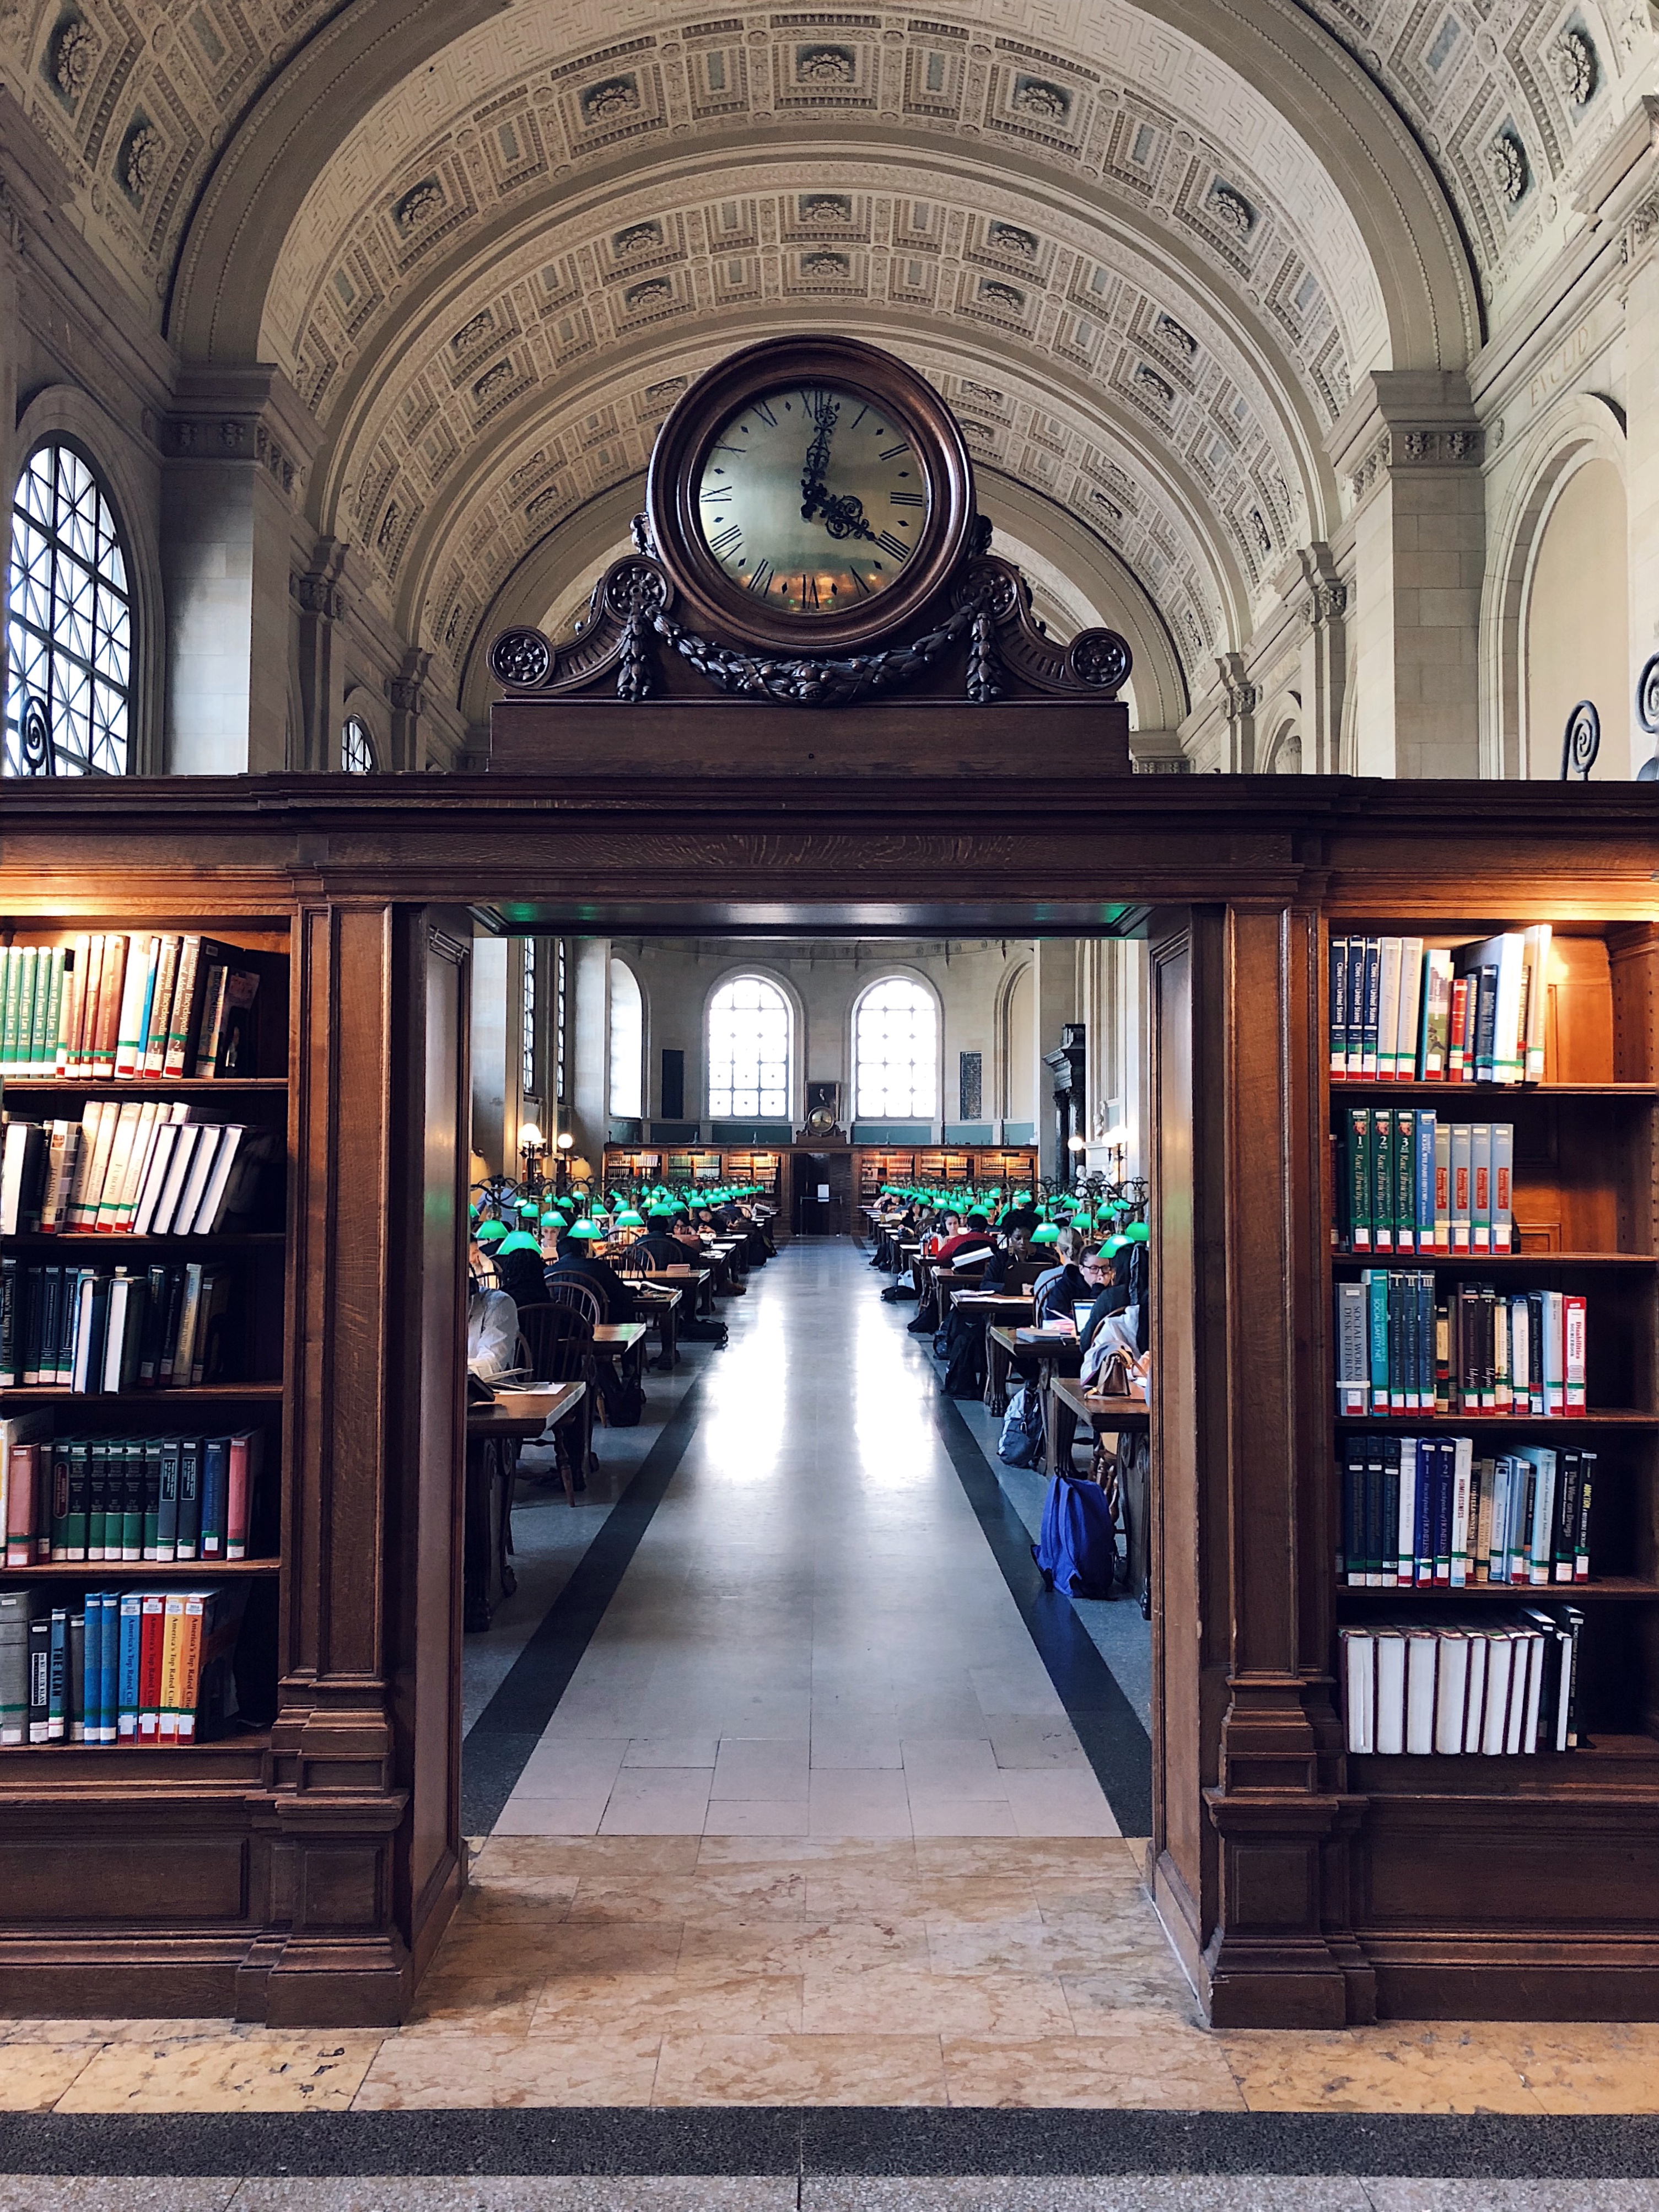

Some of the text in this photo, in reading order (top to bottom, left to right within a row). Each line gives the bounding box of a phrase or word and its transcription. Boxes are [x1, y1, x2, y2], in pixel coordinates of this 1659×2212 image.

[890, 491, 923, 507] III
[158, 949, 177, 1035] International Encyclopedia
[173, 976, 186, 1016] Adolescence
[179, 949, 200, 1035] International Encyclopedia
[1354, 988, 1362, 1005] United
[207, 992, 220, 1032] DICTIONARY
[1358, 1136, 1362, 1145] 1
[1380, 1137, 1387, 1145] 2
[1402, 1138, 1409, 1147] 3
[1354, 1154, 1364, 1170] Race,
[1376, 1154, 1386, 1170] Race,
[1399, 1155, 1409, 1171] Race,
[108, 1164, 123, 1196] EUROPE
[1353, 1172, 1364, 1201] Ethnicity,
[1375, 1172, 1386, 1201] Ethnicity,
[1398, 1172, 1409, 1201] Ethnicity,
[1395, 1278, 1399, 1287] I
[1408, 1278, 1415, 1287] II
[1423, 1278, 1433, 1287] III
[1353, 1306, 1361, 1341] SOCIAL
[1344, 1308, 1353, 1381] DESK REFERENC
[1466, 1367, 1479, 1388] Adopti
[1481, 1367, 1495, 1388] Adopti
[1425, 1465, 1429, 1474] 1
[1443, 1465, 1448, 1474] 2
[1457, 1479, 1466, 1519] HOMELESSNESS
[1563, 1471, 1577, 1537] The War on Drugs
[1582, 1484, 1592, 1509] ADDICTION
[1468, 1482, 1477, 1538] HOMELESSNESS
[170, 1617, 179, 1651] America's
[189, 1617, 198, 1651] America's
[40, 1661, 47, 1671] KU
[126, 1654, 134, 1667] Top
[168, 1654, 177, 1666] Top
[186, 1654, 196, 1667] Top
[52, 1647, 63, 1697] THE KLAN
